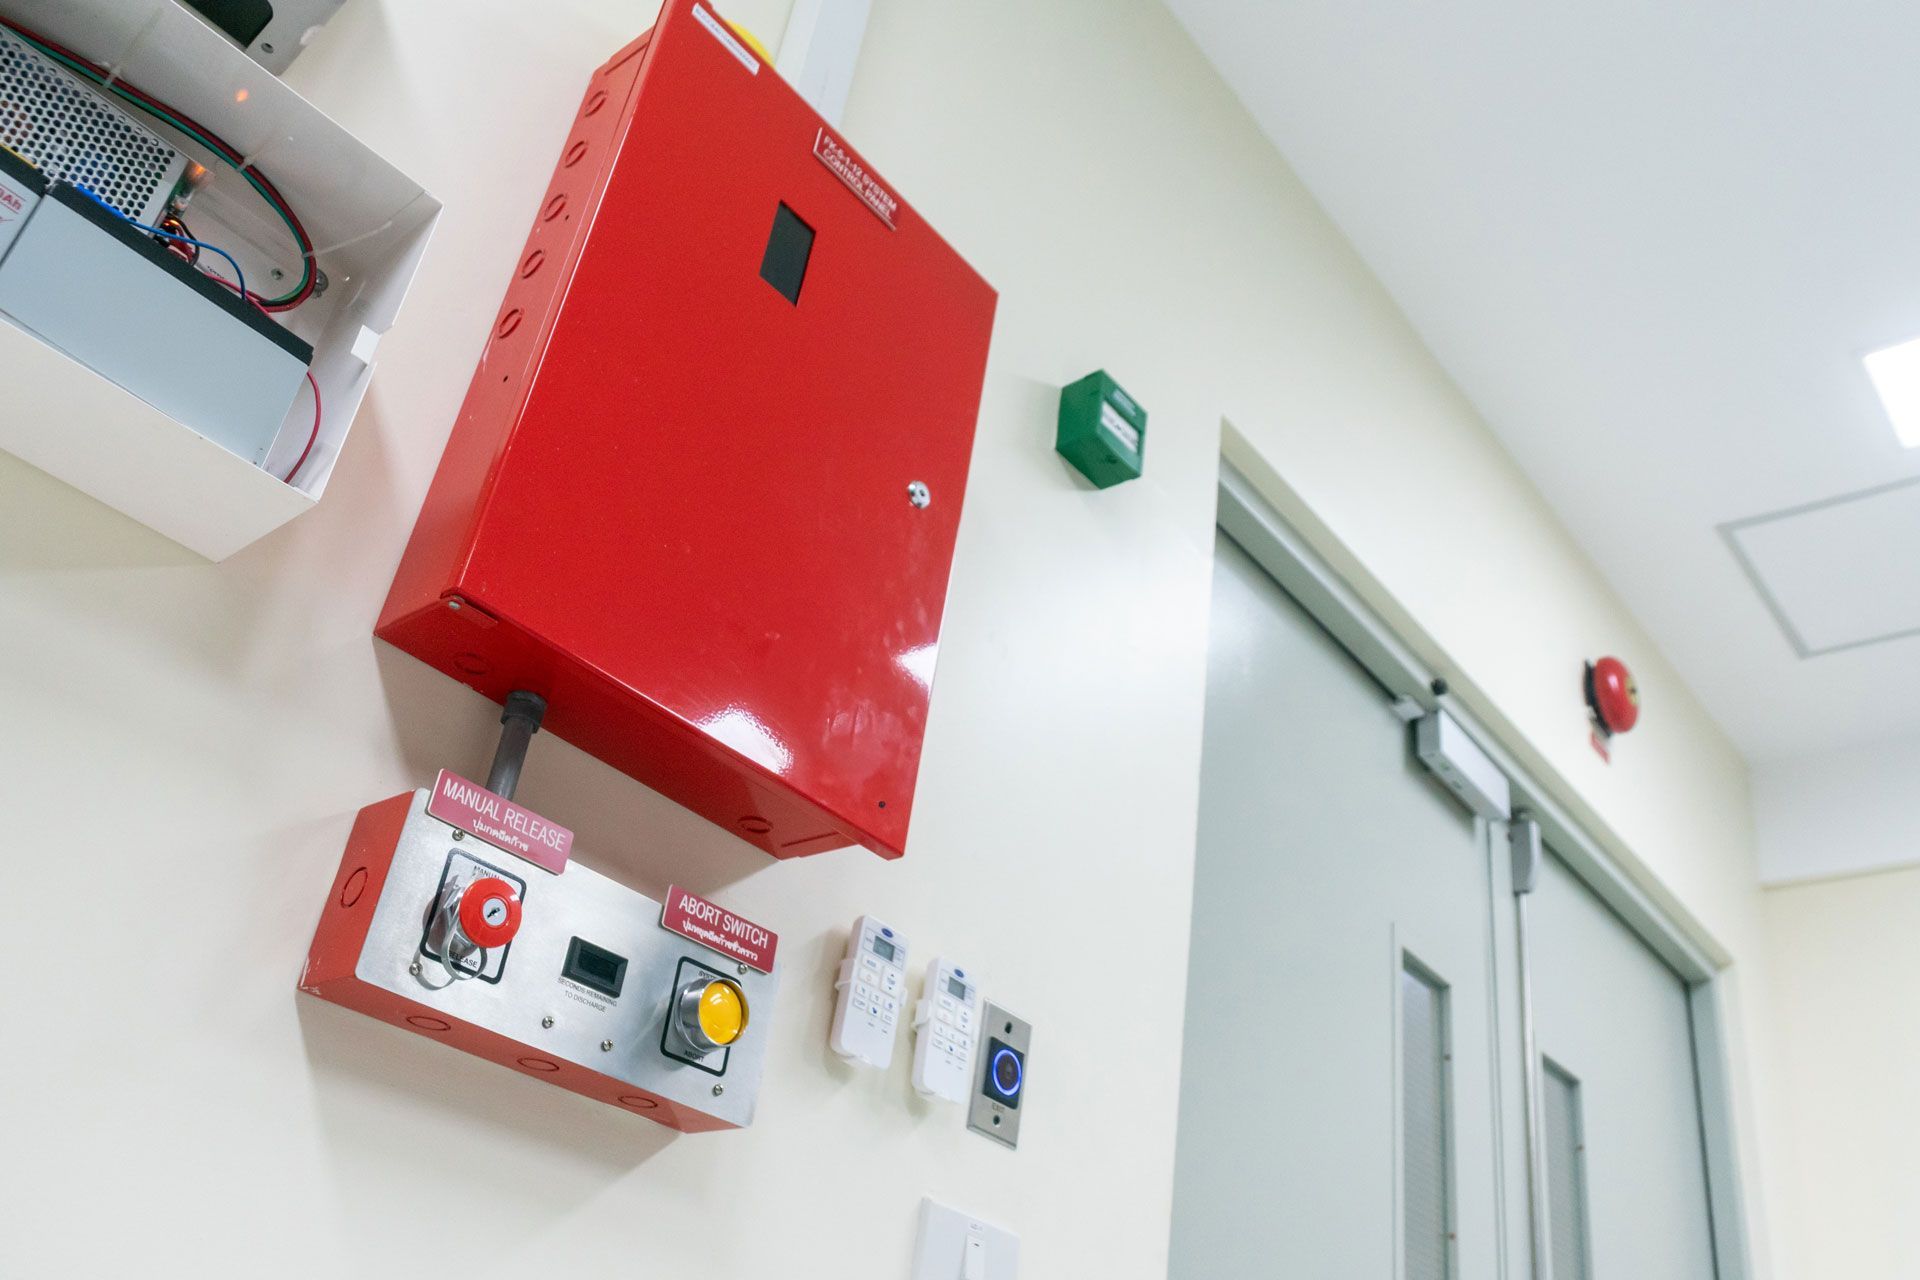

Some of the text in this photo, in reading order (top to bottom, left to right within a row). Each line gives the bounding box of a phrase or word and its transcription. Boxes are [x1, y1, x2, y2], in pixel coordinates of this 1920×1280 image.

[823, 149, 892, 220] CONTROL PANEL
[862, 173, 898, 213] SYSTEM
[443, 778, 567, 852] MANUAL RELEASE
[679, 895, 769, 949] ABORT SWITCH
[558, 977, 618, 1007] SECONDS REMAINING
[565, 990, 607, 1012] TO DISCHARGE
